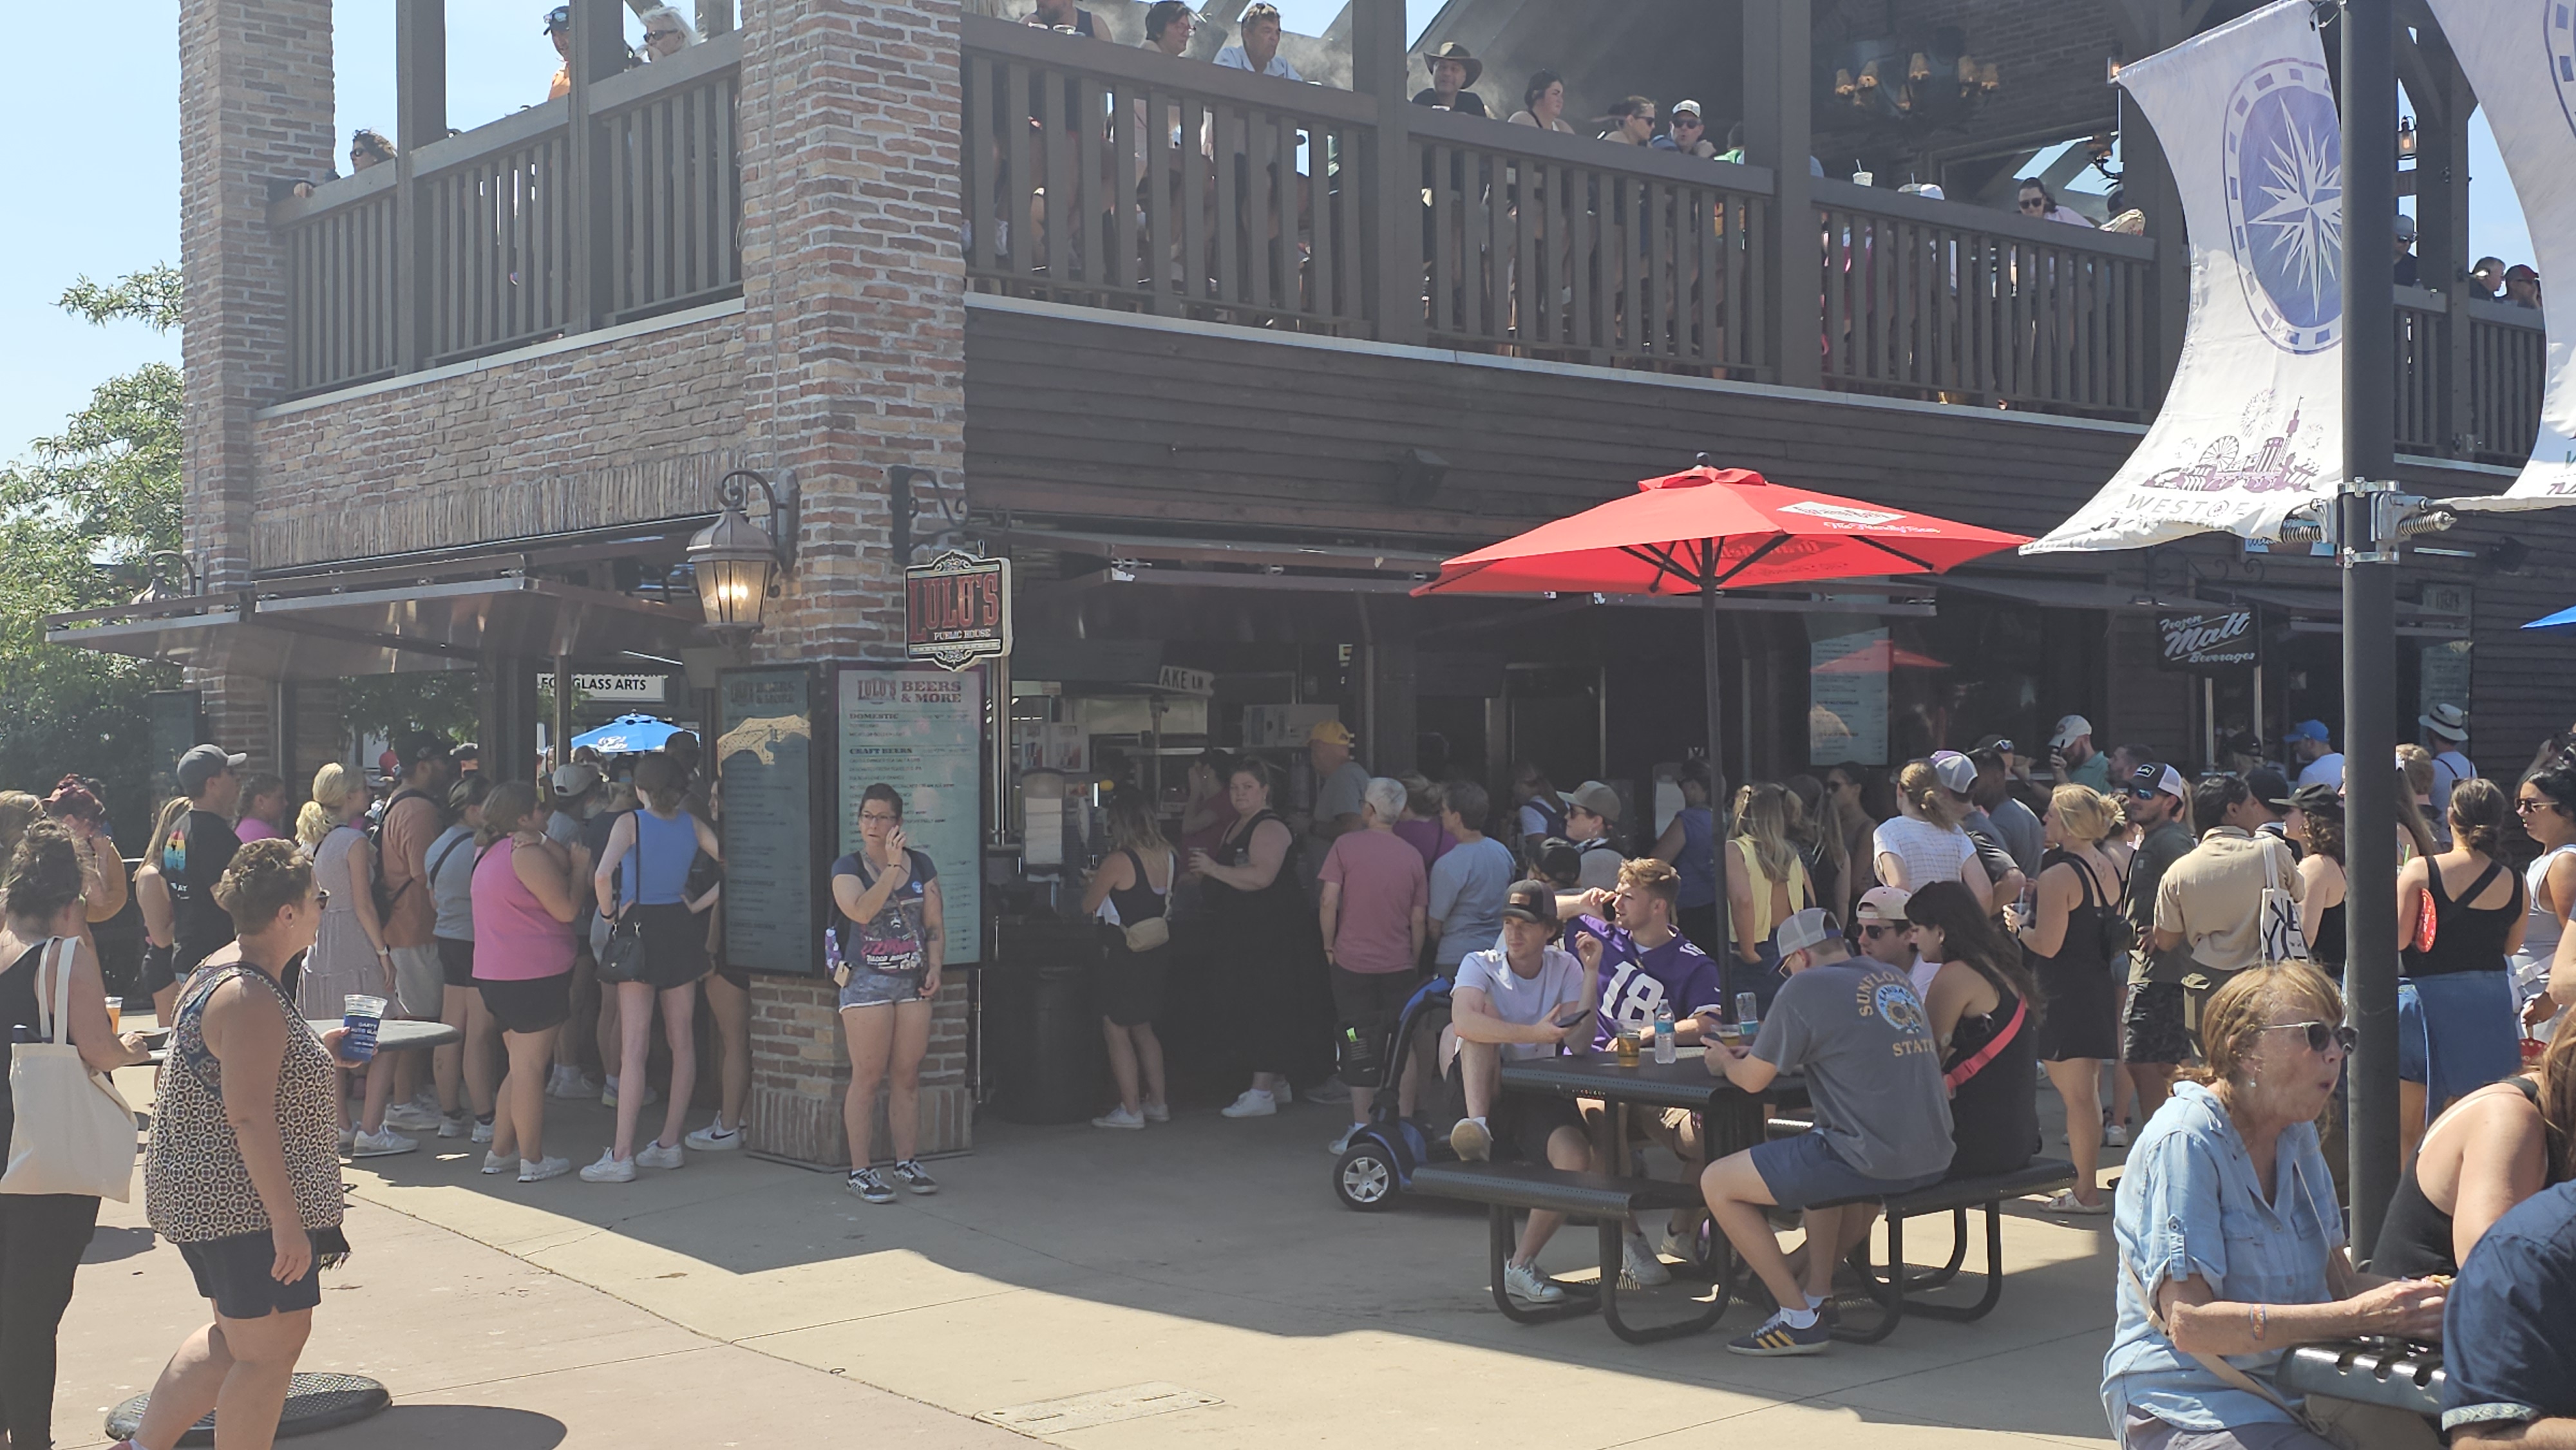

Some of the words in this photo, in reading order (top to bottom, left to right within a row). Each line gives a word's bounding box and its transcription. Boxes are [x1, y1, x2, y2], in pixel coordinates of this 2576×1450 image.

[2125, 494, 2208, 514] WEST
[908, 572, 999, 643] LULU'S
[2159, 615, 2202, 632] Frozen
[933, 630, 963, 641] PUBLIC
[963, 628, 991, 639] HOUSE
[2164, 612, 2251, 657] Malt
[2188, 652, 2255, 664] Beverages
[573, 678, 611, 690] GLASS
[614, 679, 647, 690] ARTS
[857, 679, 896, 701] LULU'S
[901, 681, 961, 692] BEERS
[901, 693, 911, 703] &
[915, 693, 961, 703] MORE
[1679, 942, 1707, 957] 18
[1600, 961, 1665, 1030] 18
[1856, 970, 1915, 1017] SUNFLOW
